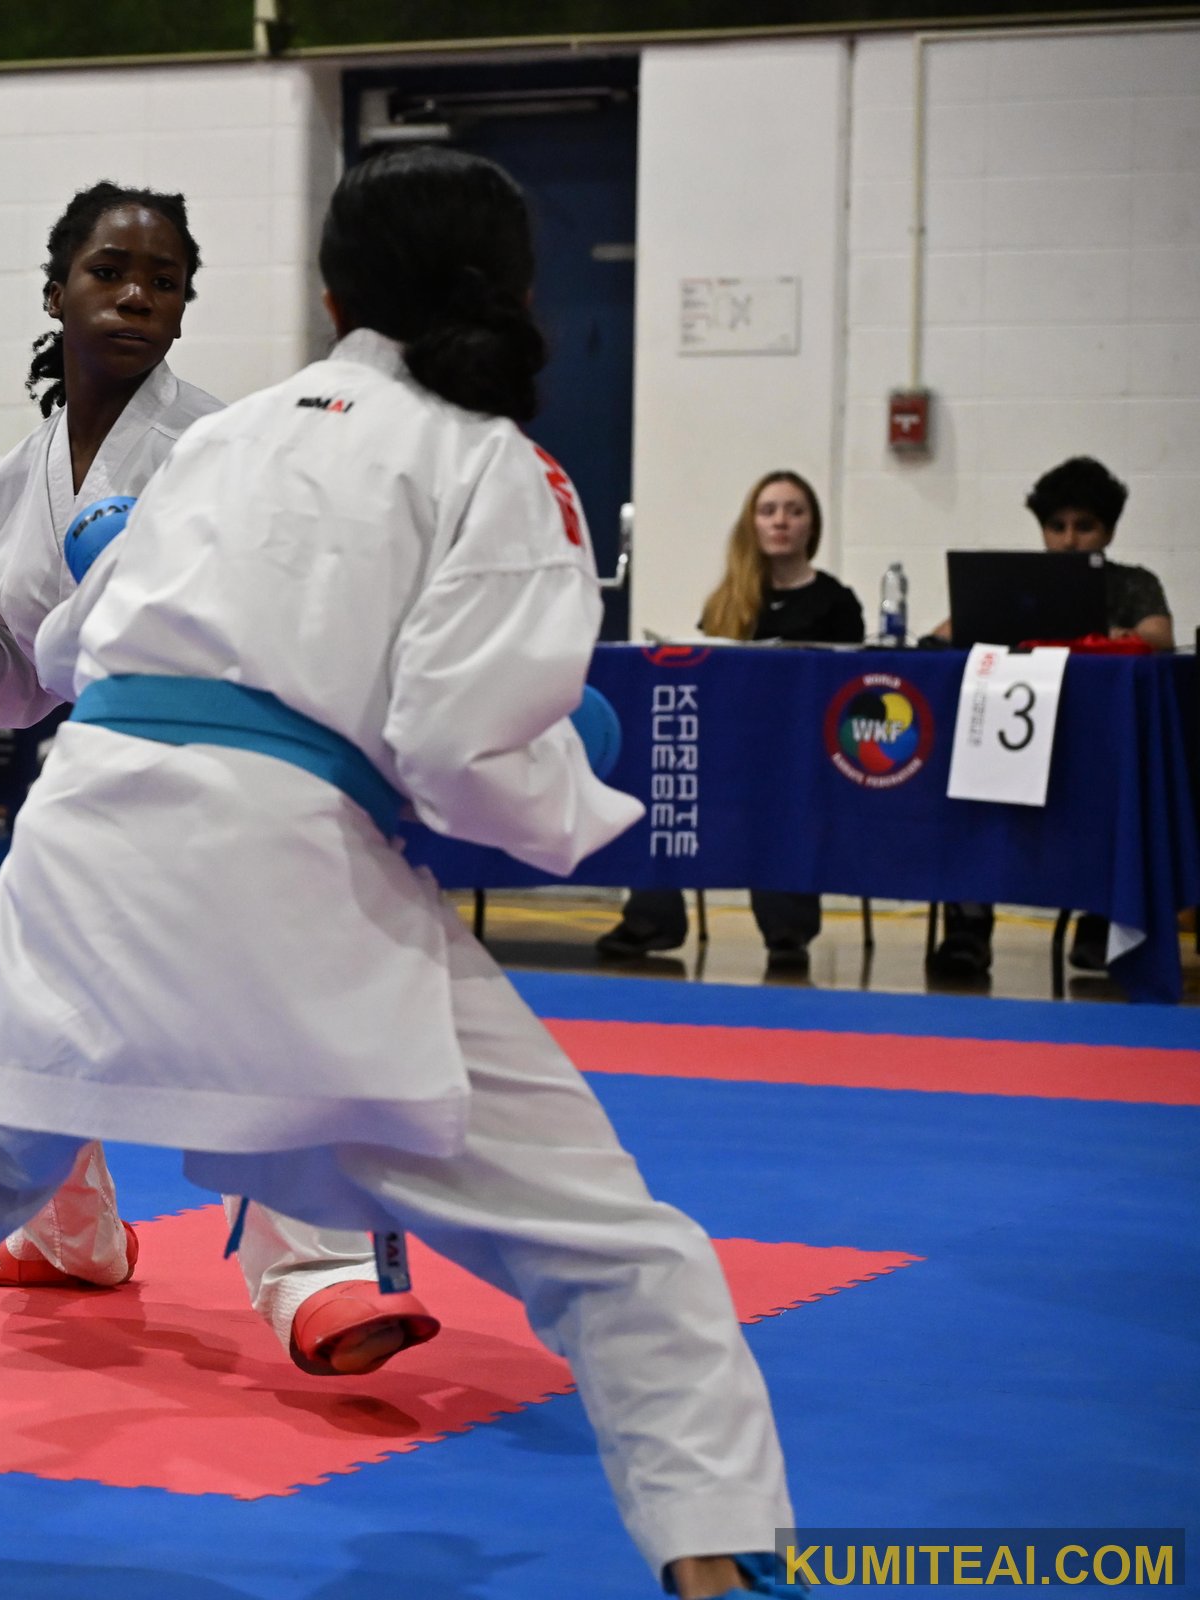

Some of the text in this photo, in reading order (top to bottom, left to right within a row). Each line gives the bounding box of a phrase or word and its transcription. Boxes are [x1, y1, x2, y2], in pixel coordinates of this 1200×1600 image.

[295, 397, 355, 414] SMAI
[998, 682, 1037, 751] 3
[851, 717, 904, 744] WKF
